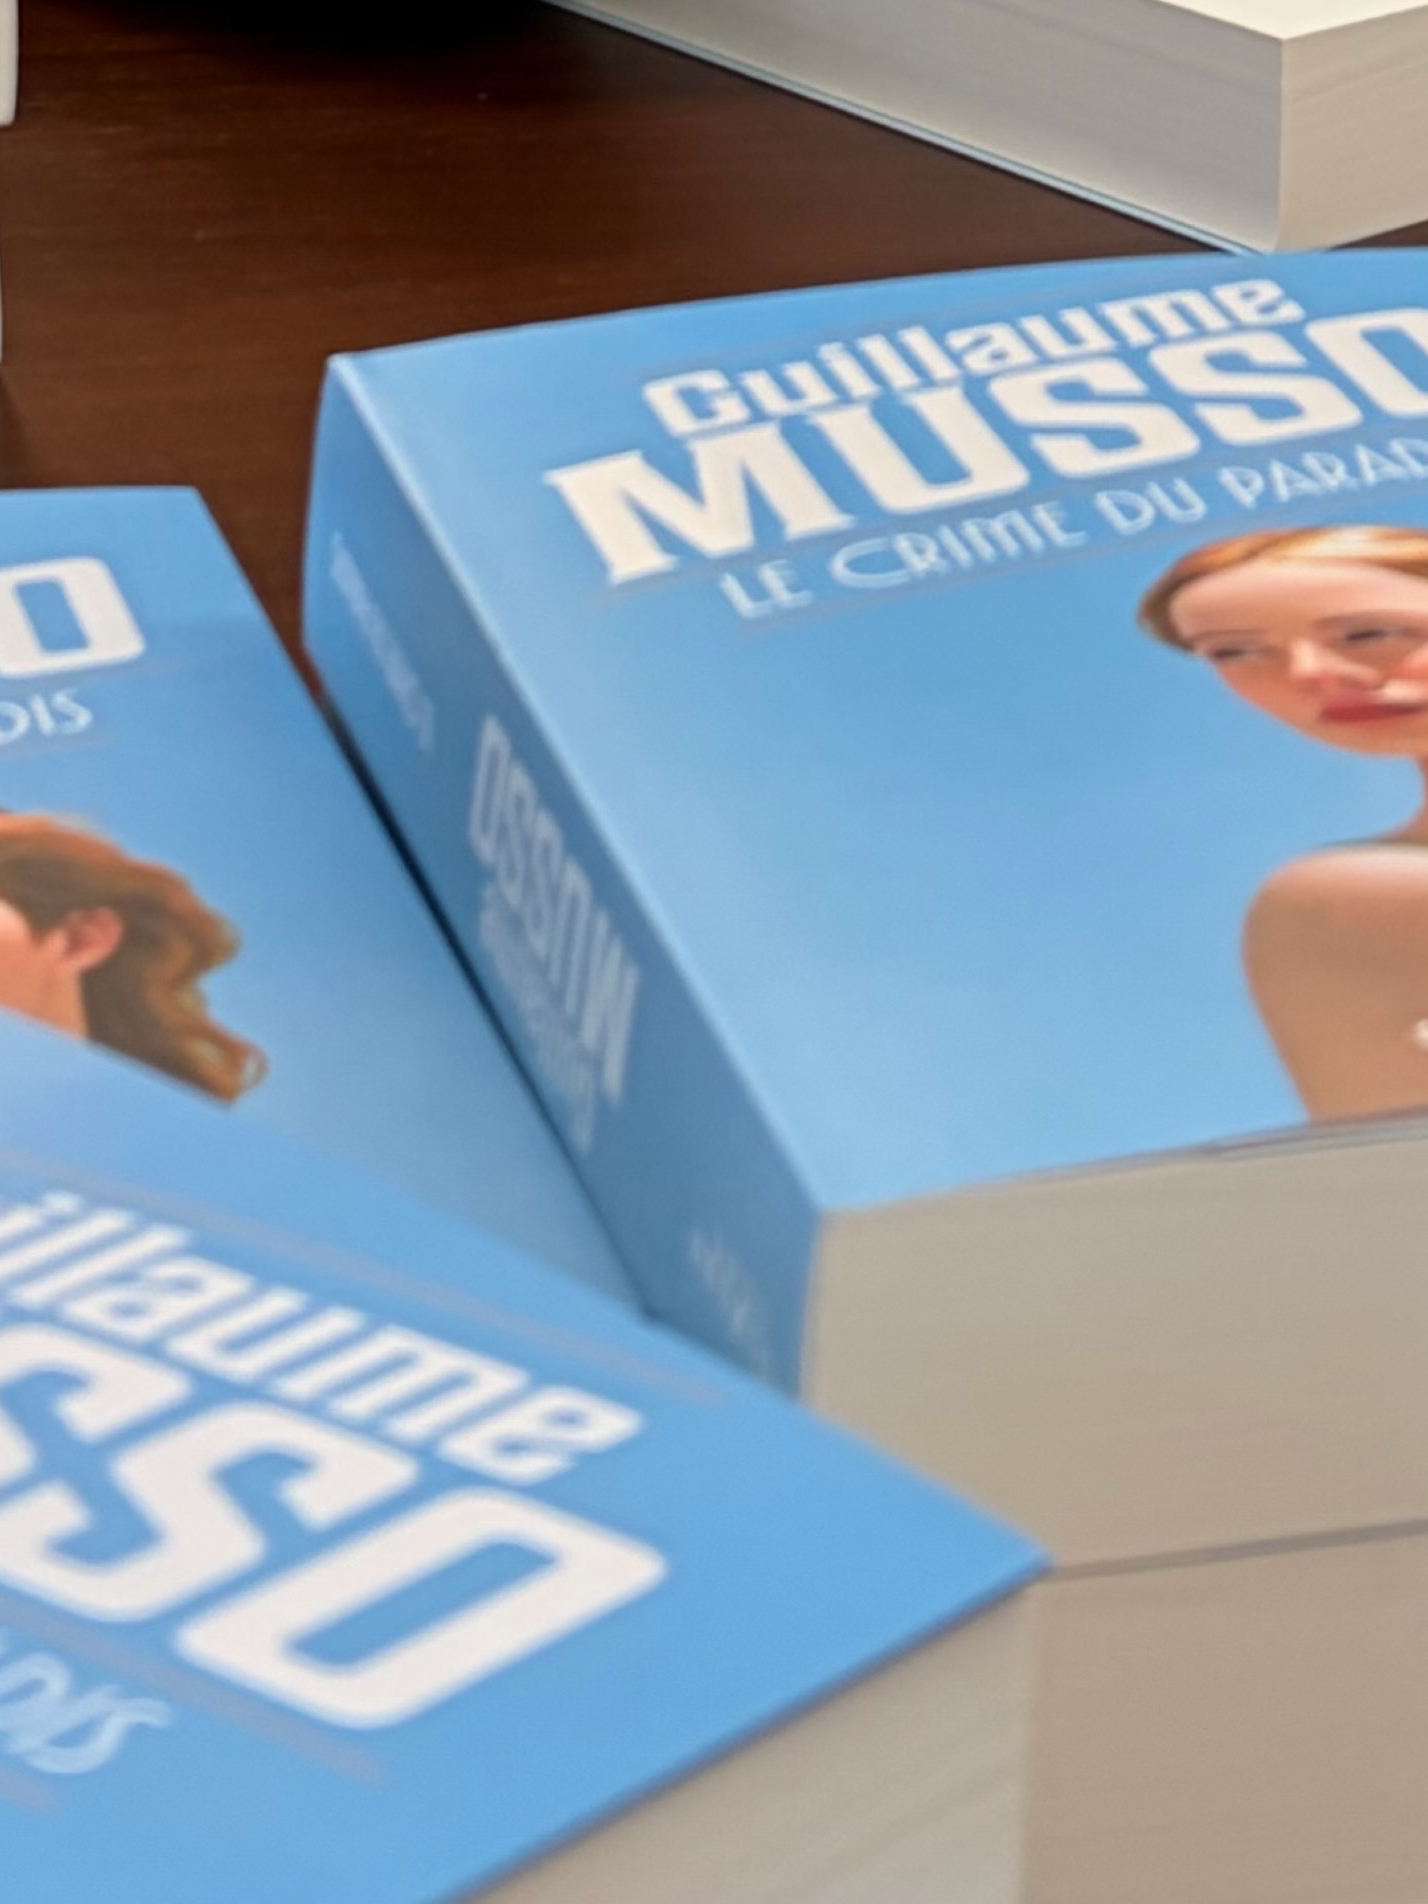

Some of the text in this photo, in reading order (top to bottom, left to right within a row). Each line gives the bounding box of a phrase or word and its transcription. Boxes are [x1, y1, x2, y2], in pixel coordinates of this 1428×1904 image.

[641, 278, 1306, 440] Guillaume
[719, 558, 814, 620] LE
[830, 501, 1089, 589] CRIME
[1094, 477, 1208, 537] DU
